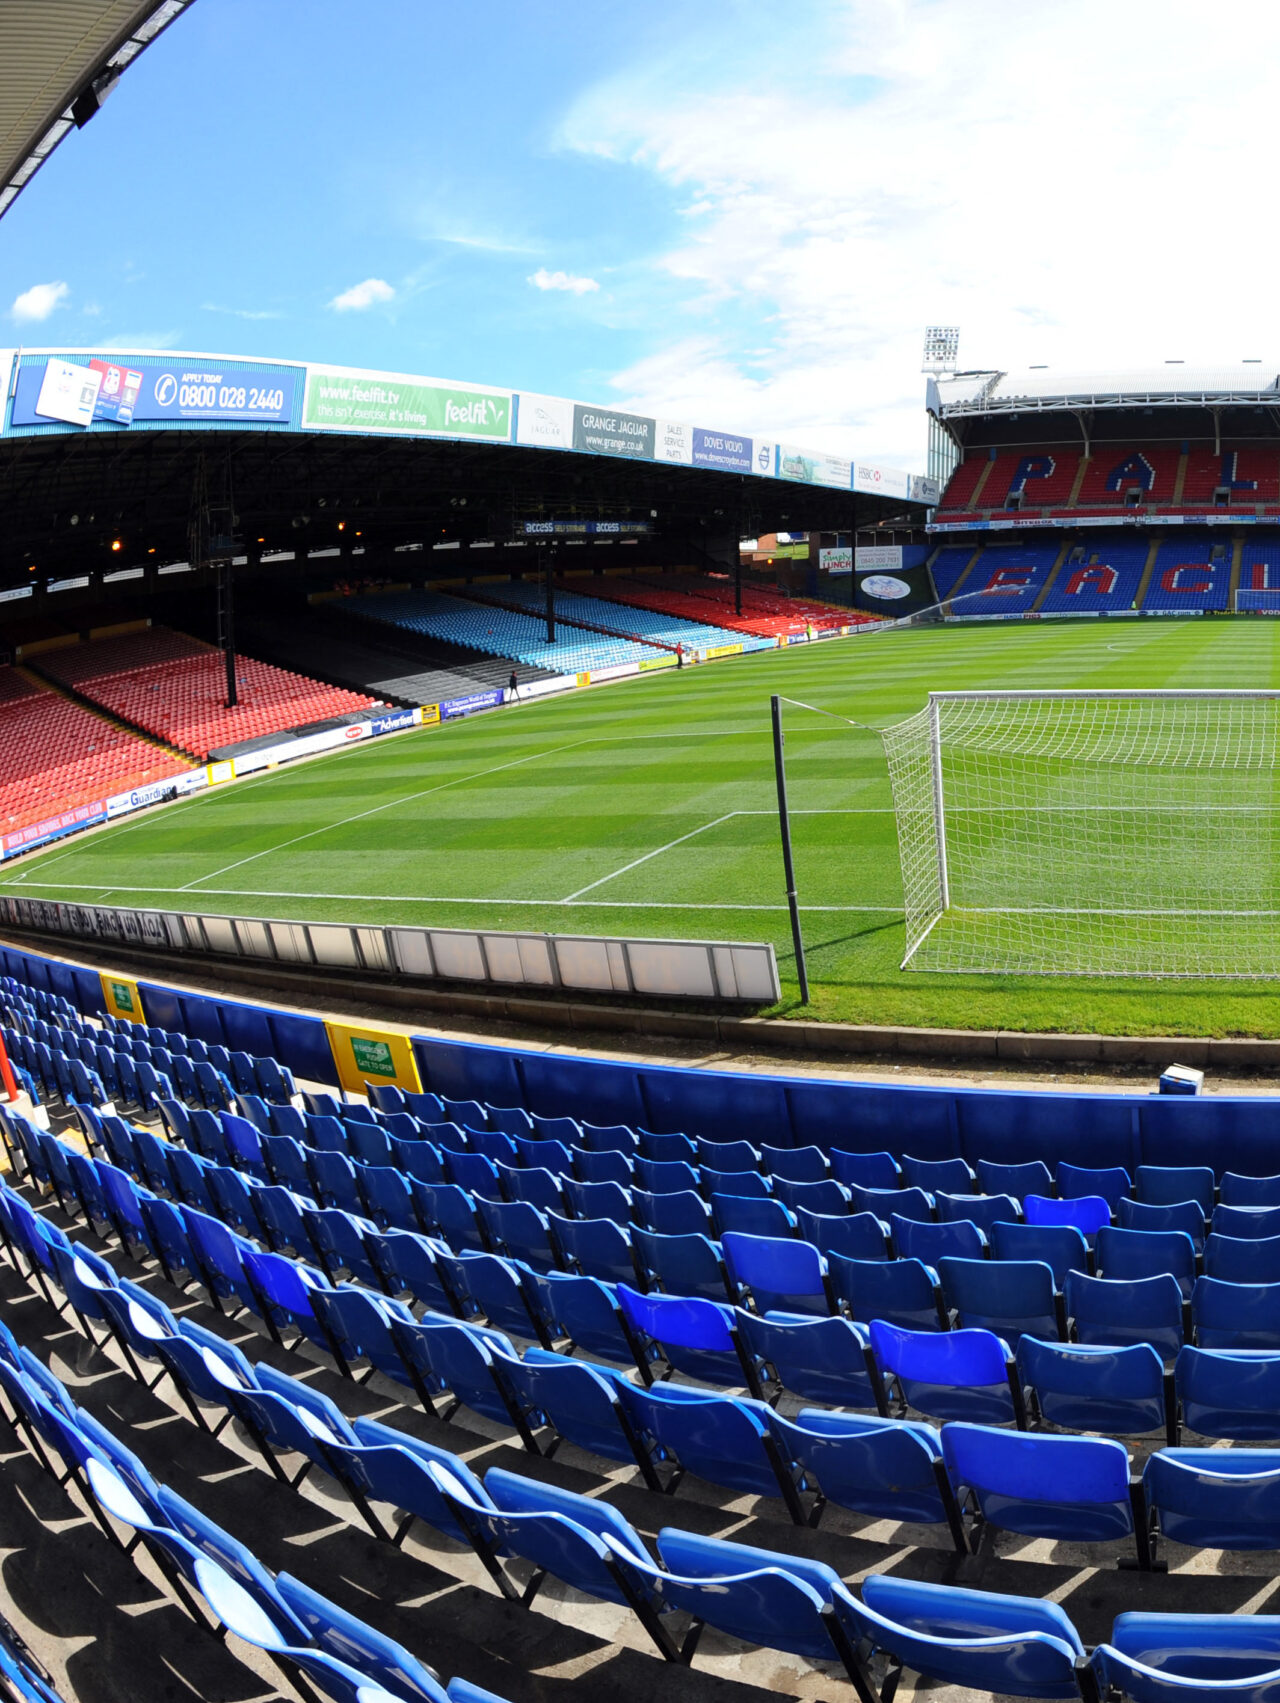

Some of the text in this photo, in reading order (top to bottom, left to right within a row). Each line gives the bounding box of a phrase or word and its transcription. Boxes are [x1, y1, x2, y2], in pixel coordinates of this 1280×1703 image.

[181, 373, 223, 384] APPLY TODAY
[180, 384, 284, 410] 0800 028 2440
[319, 385, 400, 405] www.feelfit.tv
[404, 411, 427, 426] living
[445, 399, 488, 426] feelfit
[582, 414, 648, 438] GRANGE JAGUAR
[667, 424, 682, 436] SALES
[585, 435, 645, 452] www.grange.co.uk
[664, 436, 685, 449] SERVICE
[704, 436, 743, 454] DOVES VOLVO
[666, 448, 682, 460] PARTS
[859, 466, 873, 481] HSBC
[526, 523, 554, 533] access
[595, 523, 620, 532] access
[380, 714, 415, 732] Advertiser
